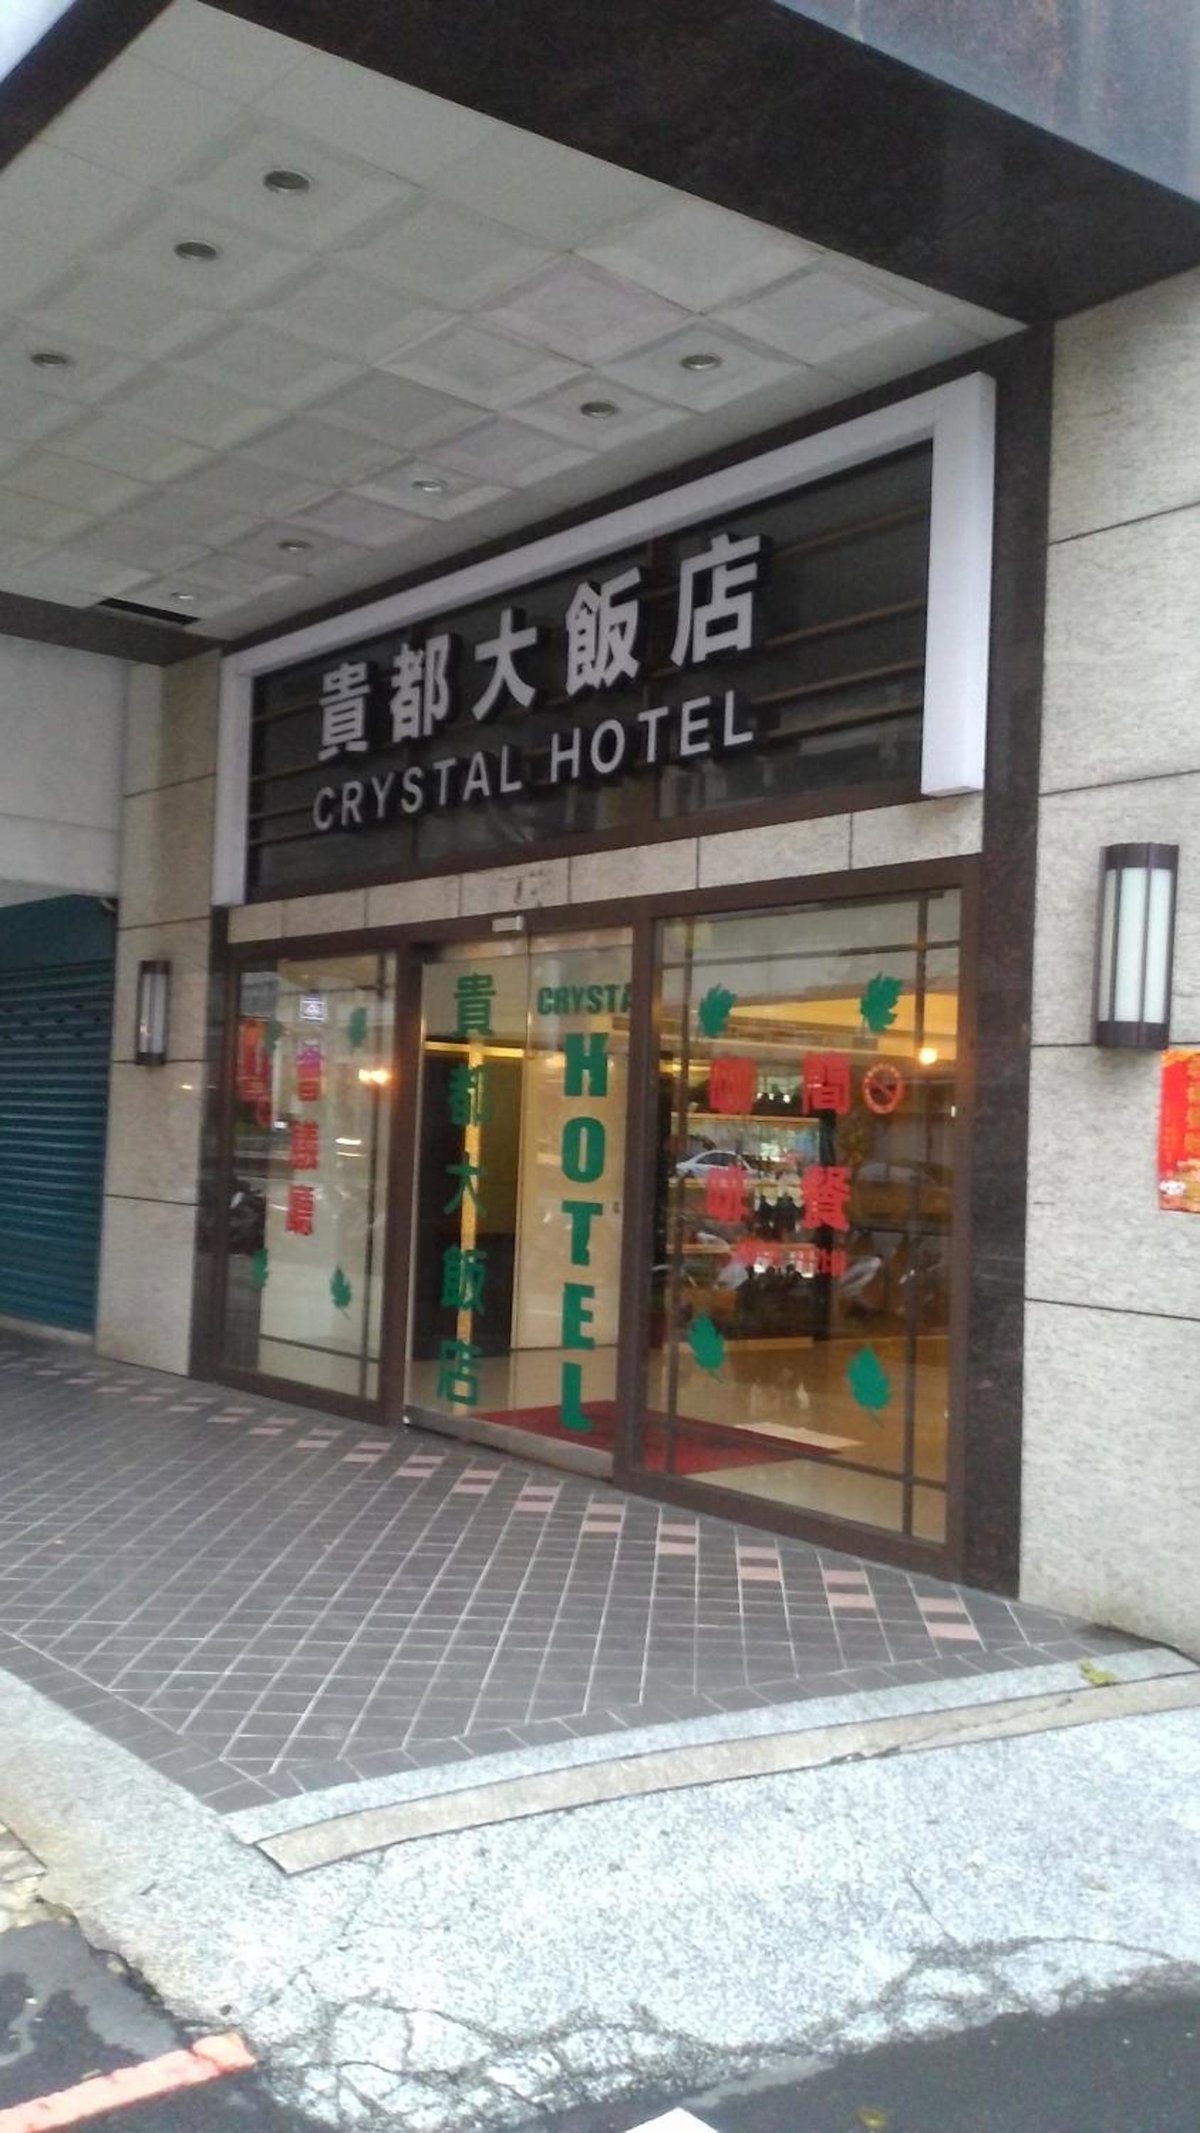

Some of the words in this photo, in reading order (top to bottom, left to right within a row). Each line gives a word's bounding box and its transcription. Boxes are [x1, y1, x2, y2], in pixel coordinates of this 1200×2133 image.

[312, 743, 523, 831] CRYSTAL
[549, 689, 755, 783] HOTEL
[318, 532, 762, 762] 貴都大飯店
[436, 972, 497, 1407] 貴都大飯店
[561, 1032, 610, 1432] HOTEL
